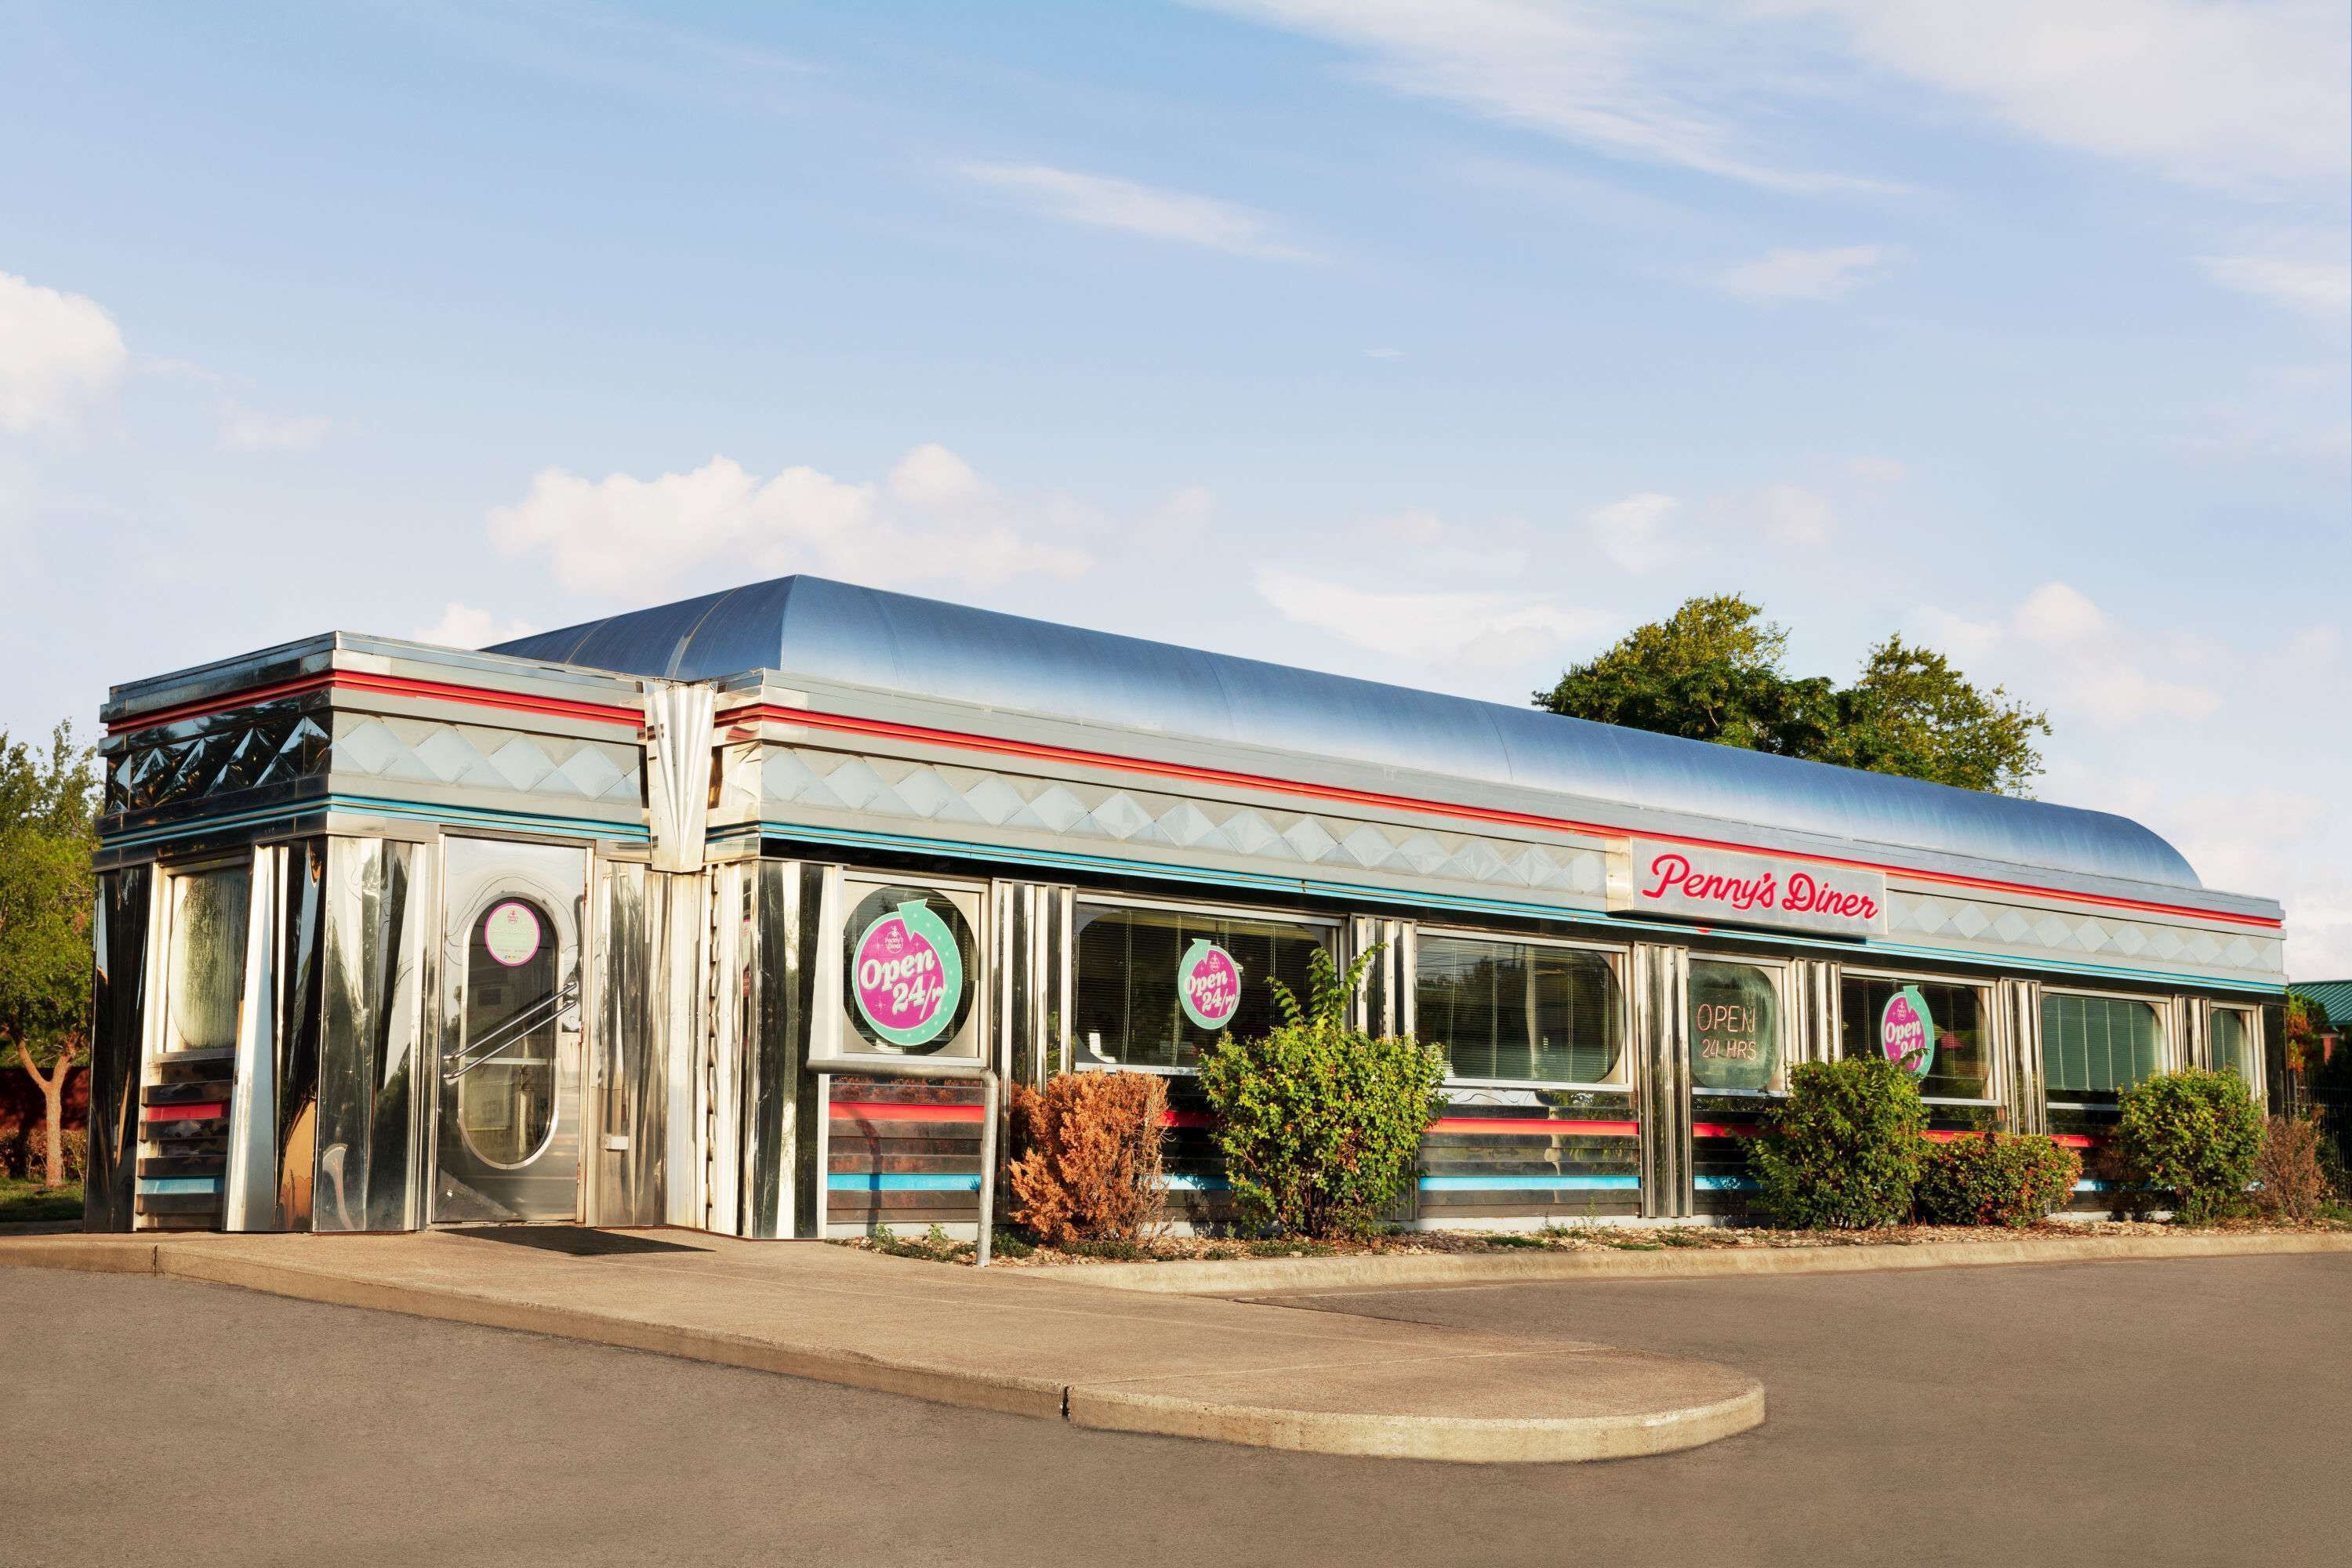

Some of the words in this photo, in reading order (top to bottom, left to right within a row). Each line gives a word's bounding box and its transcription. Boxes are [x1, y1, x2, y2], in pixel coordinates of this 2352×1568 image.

[1642, 854, 1777, 910] Penny's
[1781, 872, 1878, 920] Diner
[860, 949, 935, 992] Open
[1184, 970, 1228, 997] Open
[892, 975, 948, 1020] 24/7
[1201, 988, 1236, 1017] 24/7
[1697, 1004, 1756, 1033] OPEN
[1885, 1020, 1922, 1046] Open
[1701, 1039, 1719, 1058] 24
[1726, 1040, 1757, 1060] HRS
